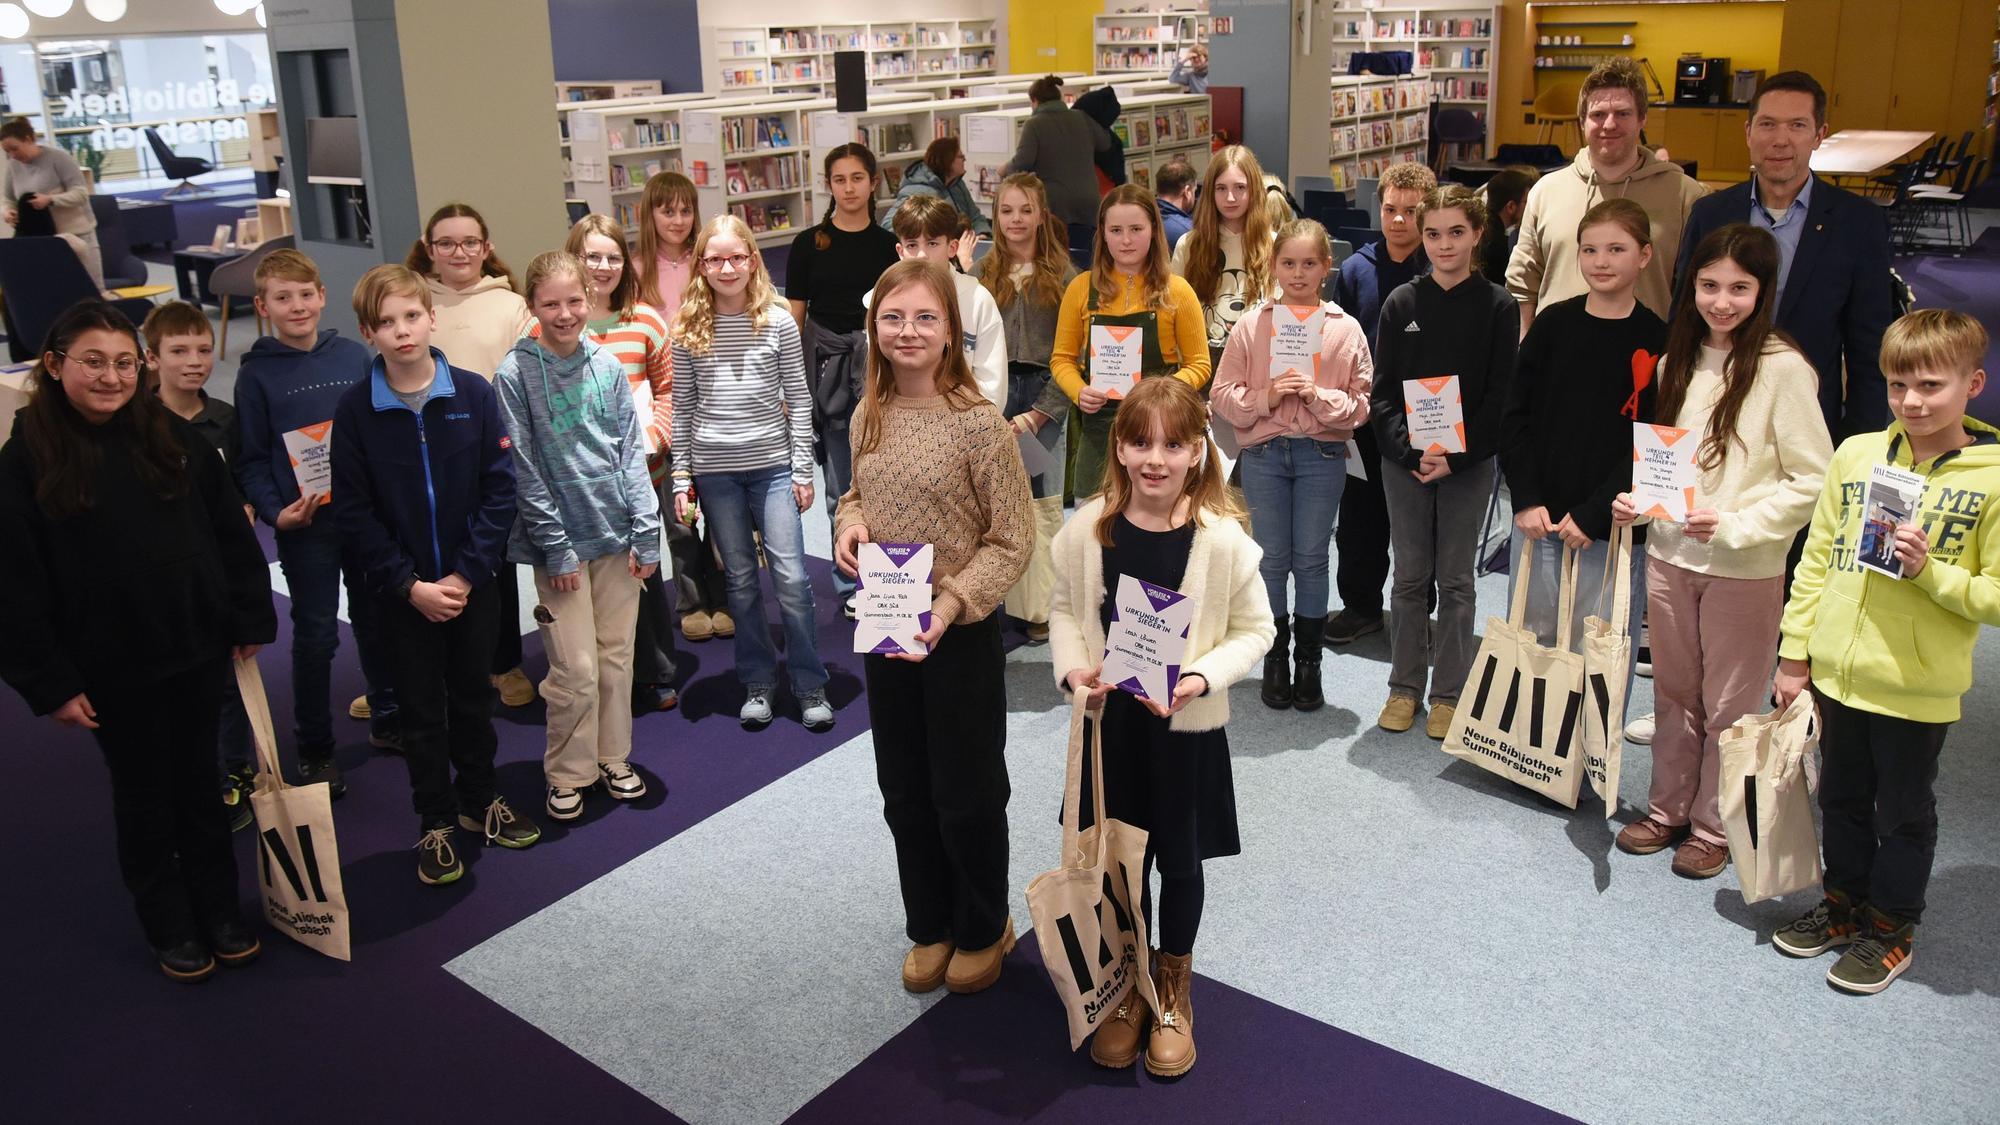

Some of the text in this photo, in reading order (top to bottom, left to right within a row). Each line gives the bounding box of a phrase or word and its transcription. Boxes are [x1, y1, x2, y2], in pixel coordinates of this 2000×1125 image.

[1645, 447, 1675, 457] URKUNDE
[1932, 487, 1986, 518] ME
[1125, 606, 1159, 623] URKUNDE
[1462, 736, 1551, 784] Gummersbach
[1464, 725, 1497, 747] Neue
[1499, 740, 1564, 778] Bibliothek
[1084, 979, 1112, 1015] Nue
